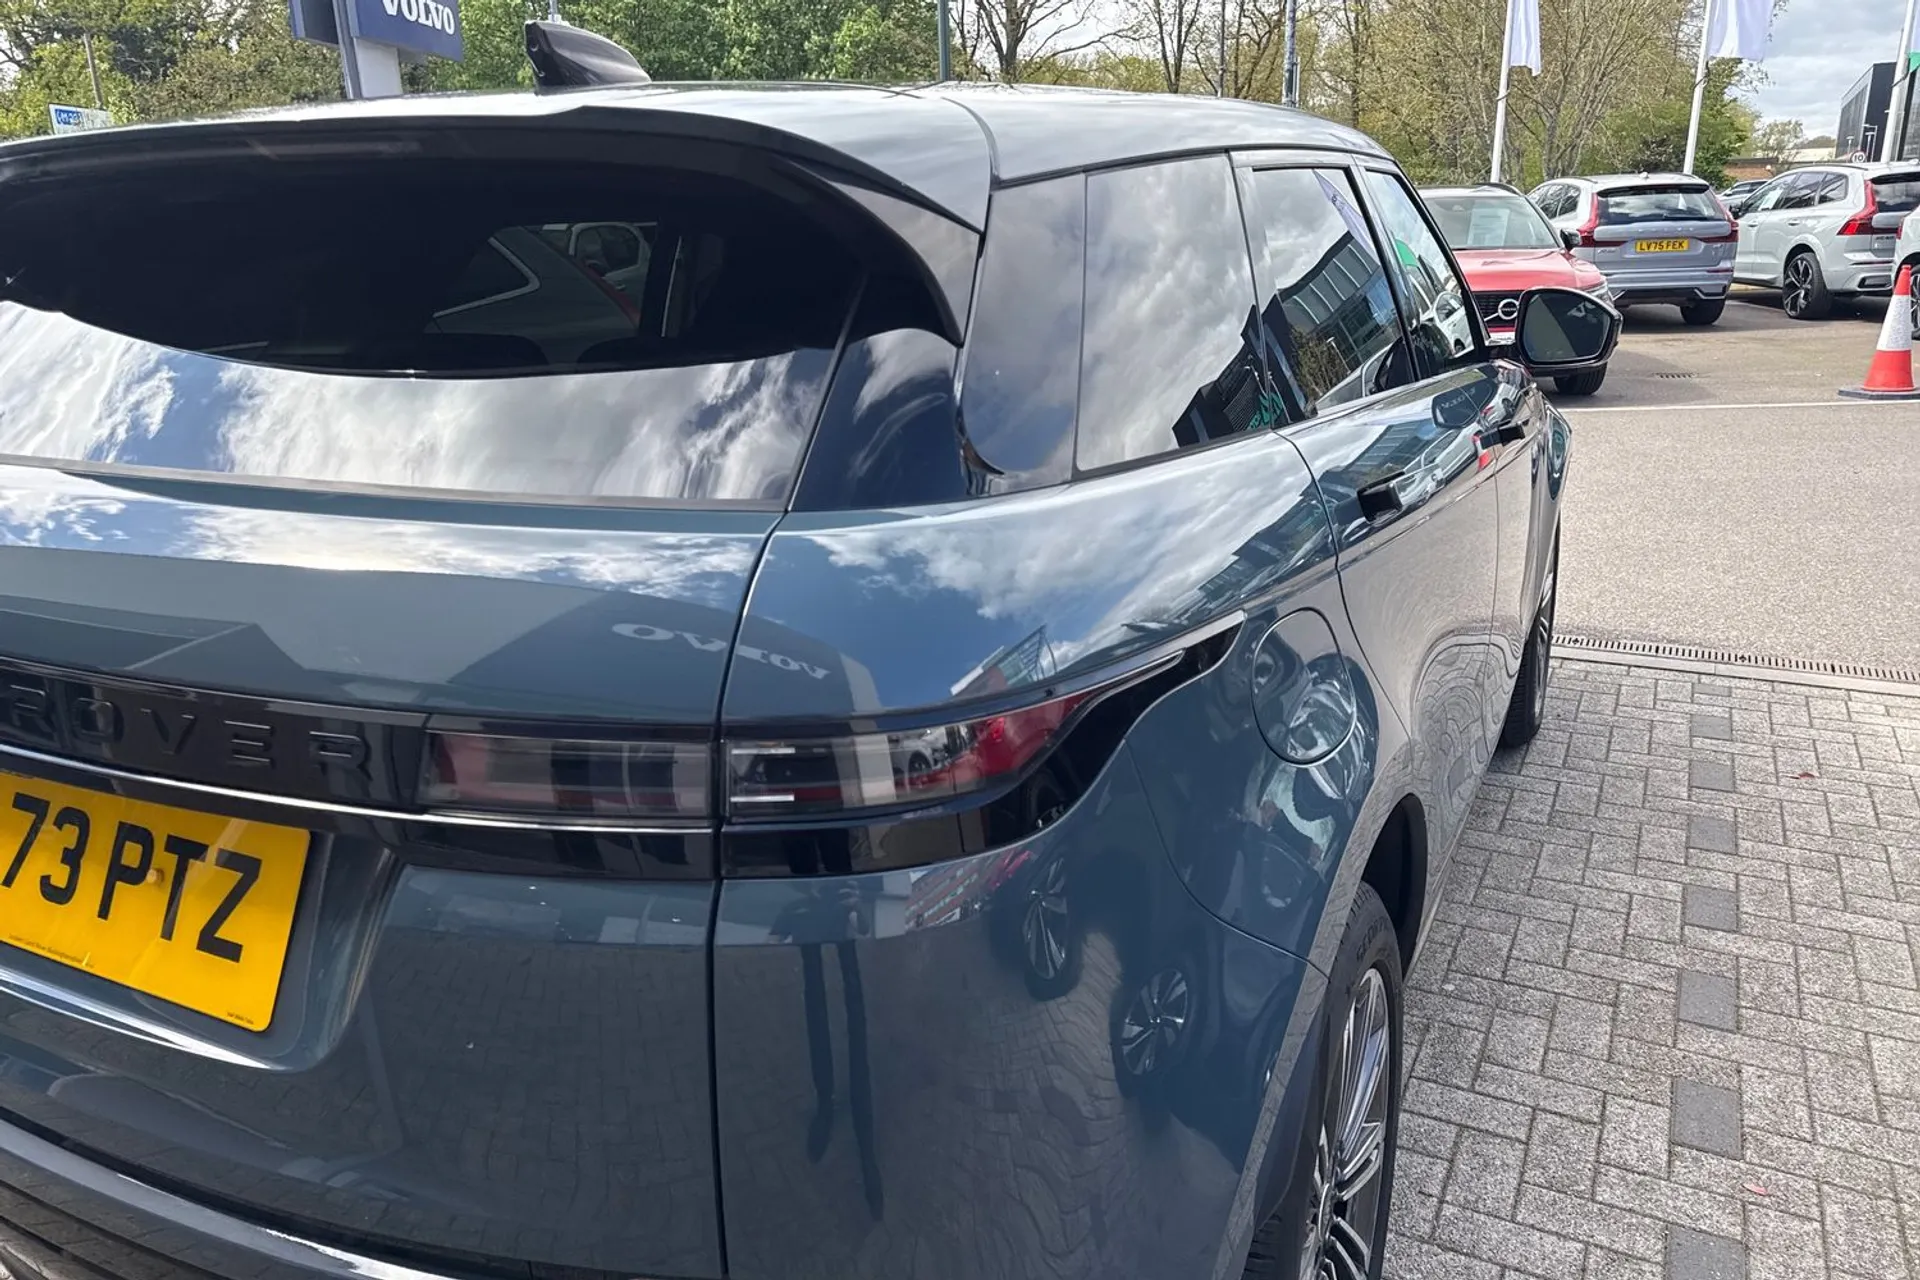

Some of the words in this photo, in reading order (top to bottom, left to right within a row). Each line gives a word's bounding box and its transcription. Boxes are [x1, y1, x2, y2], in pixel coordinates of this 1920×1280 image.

[381, 0, 455, 35] VOLVO
[1639, 241, 1664, 251] LV75
[1666, 240, 1685, 250] FEK
[8, 682, 374, 783] ROVER
[1, 792, 91, 905] 73
[97, 820, 263, 963] PTZ
